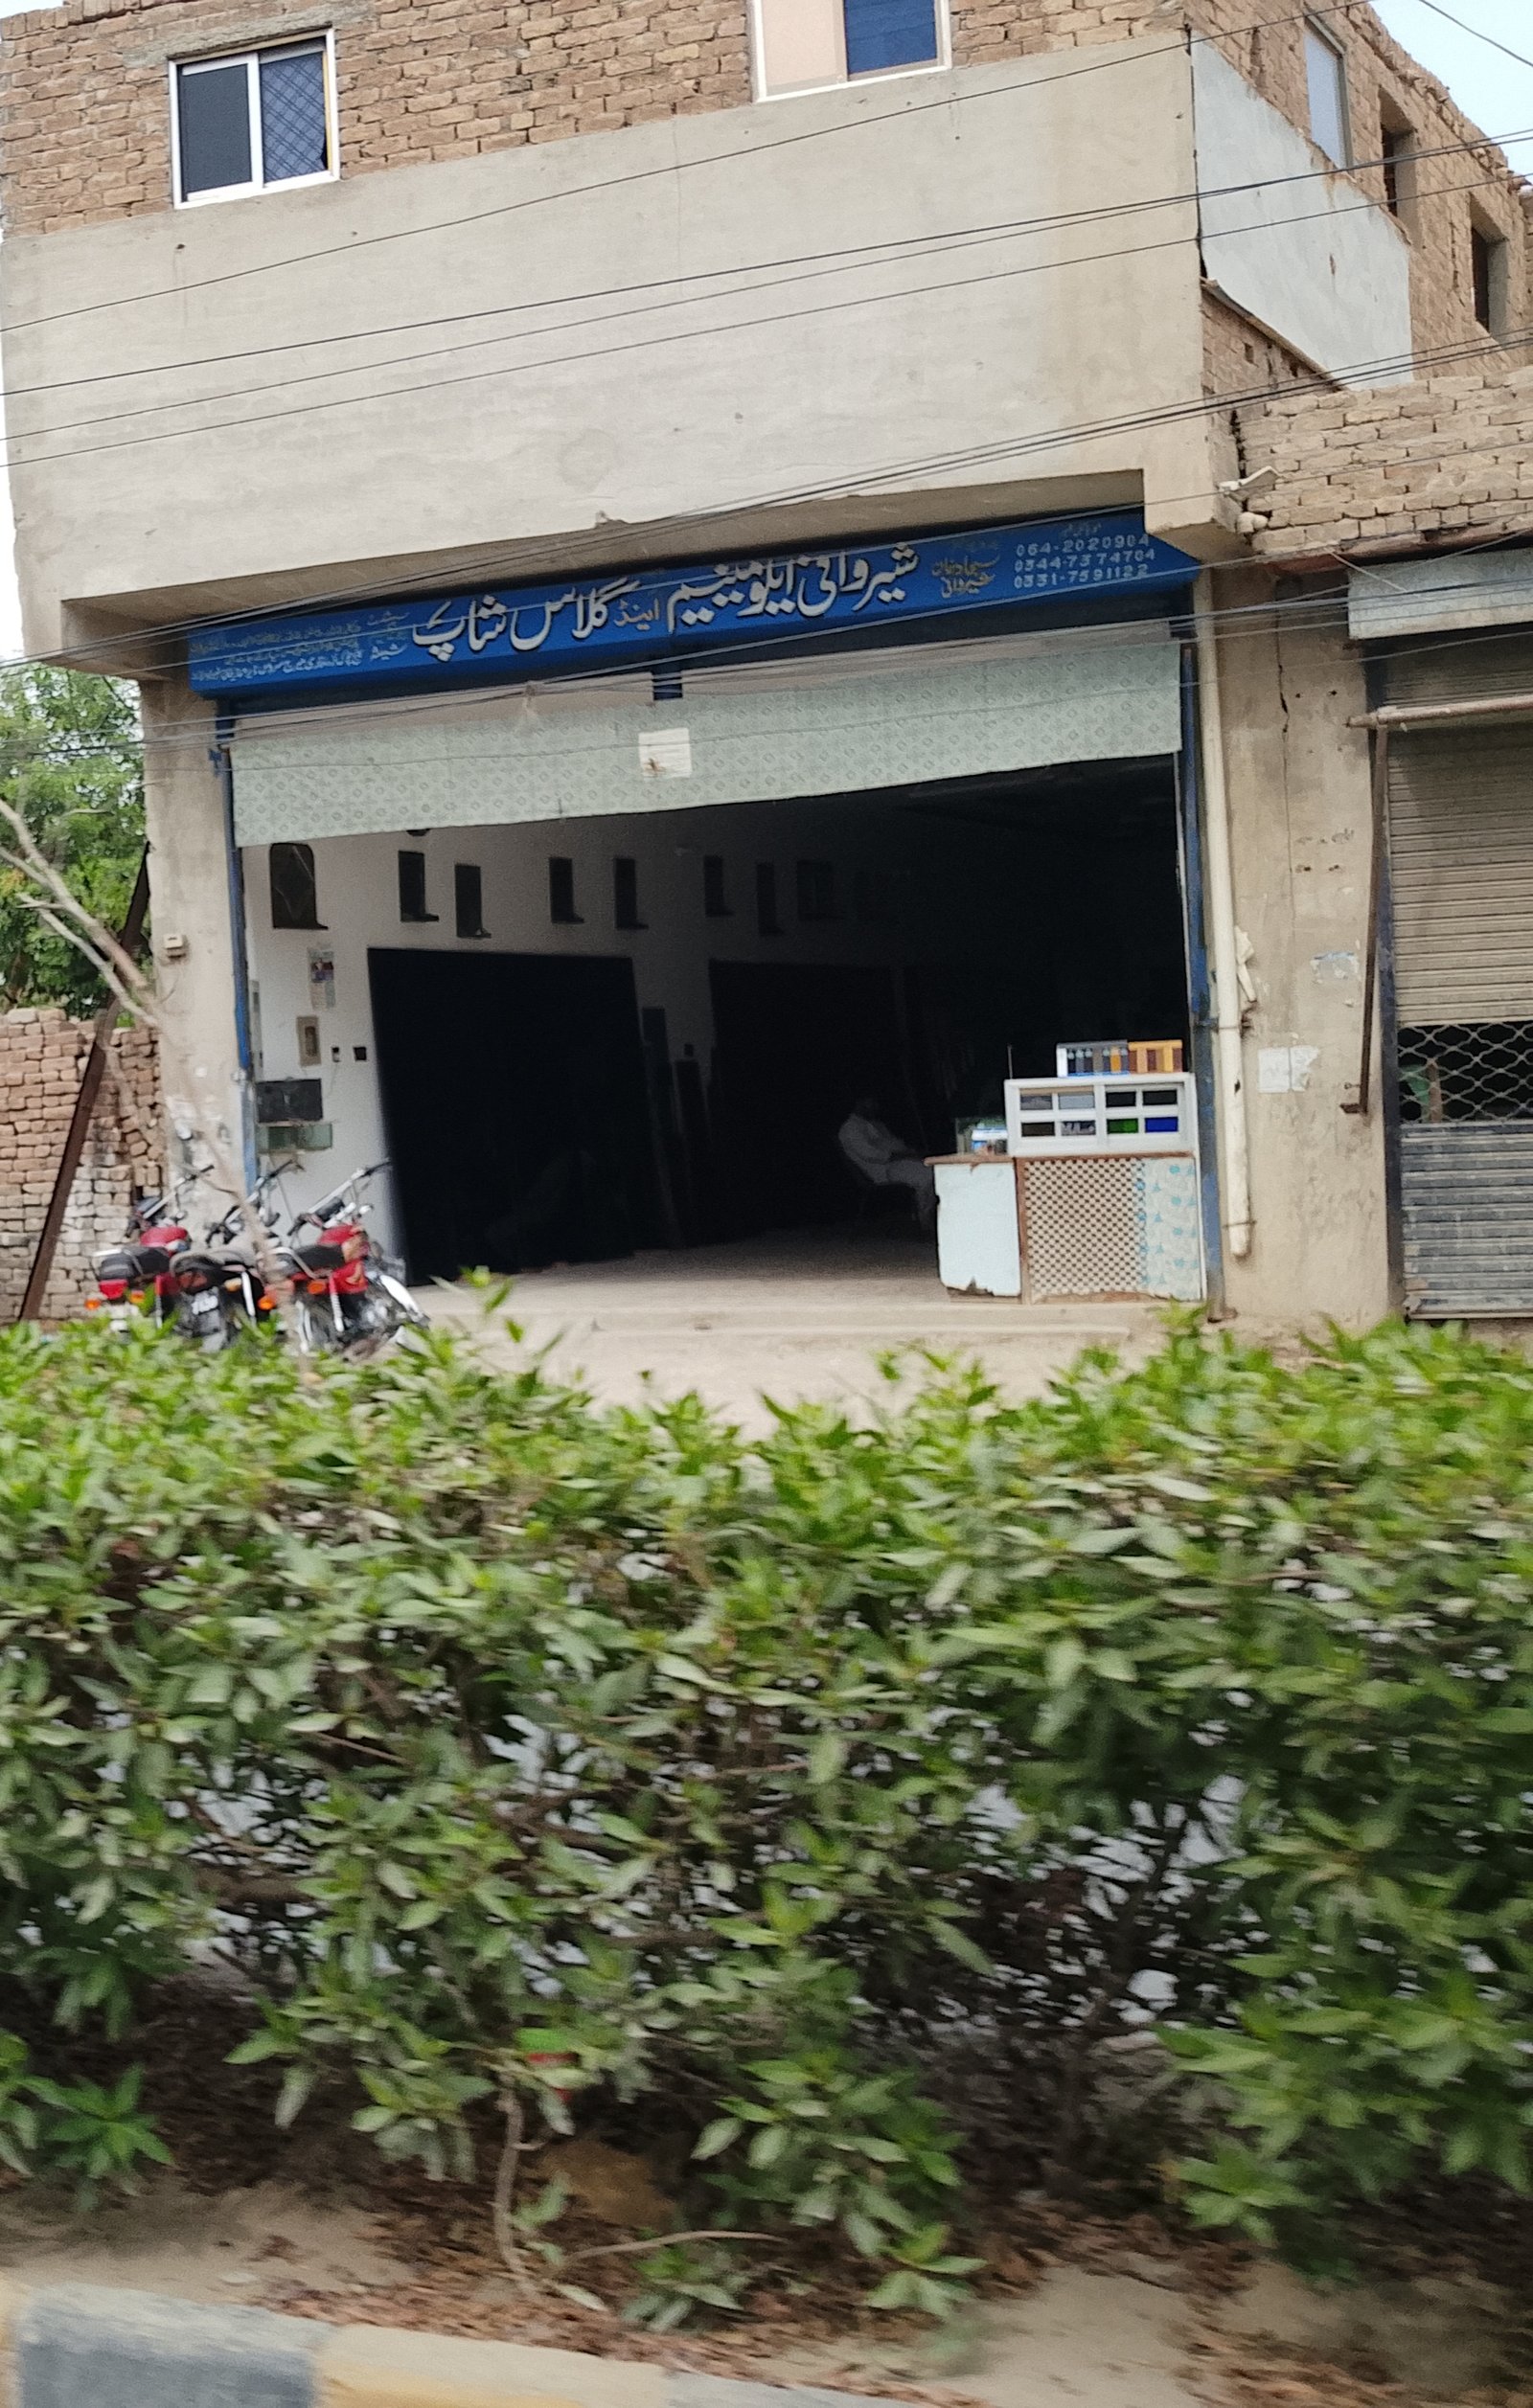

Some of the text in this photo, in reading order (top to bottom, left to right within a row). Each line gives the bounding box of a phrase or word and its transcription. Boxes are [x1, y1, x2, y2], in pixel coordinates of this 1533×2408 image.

[793, 542, 921, 618] شیروانی
[1016, 533, 1150, 557] 064-2020904
[411, 593, 508, 663] شاپ
[509, 576, 640, 651] گلاس
